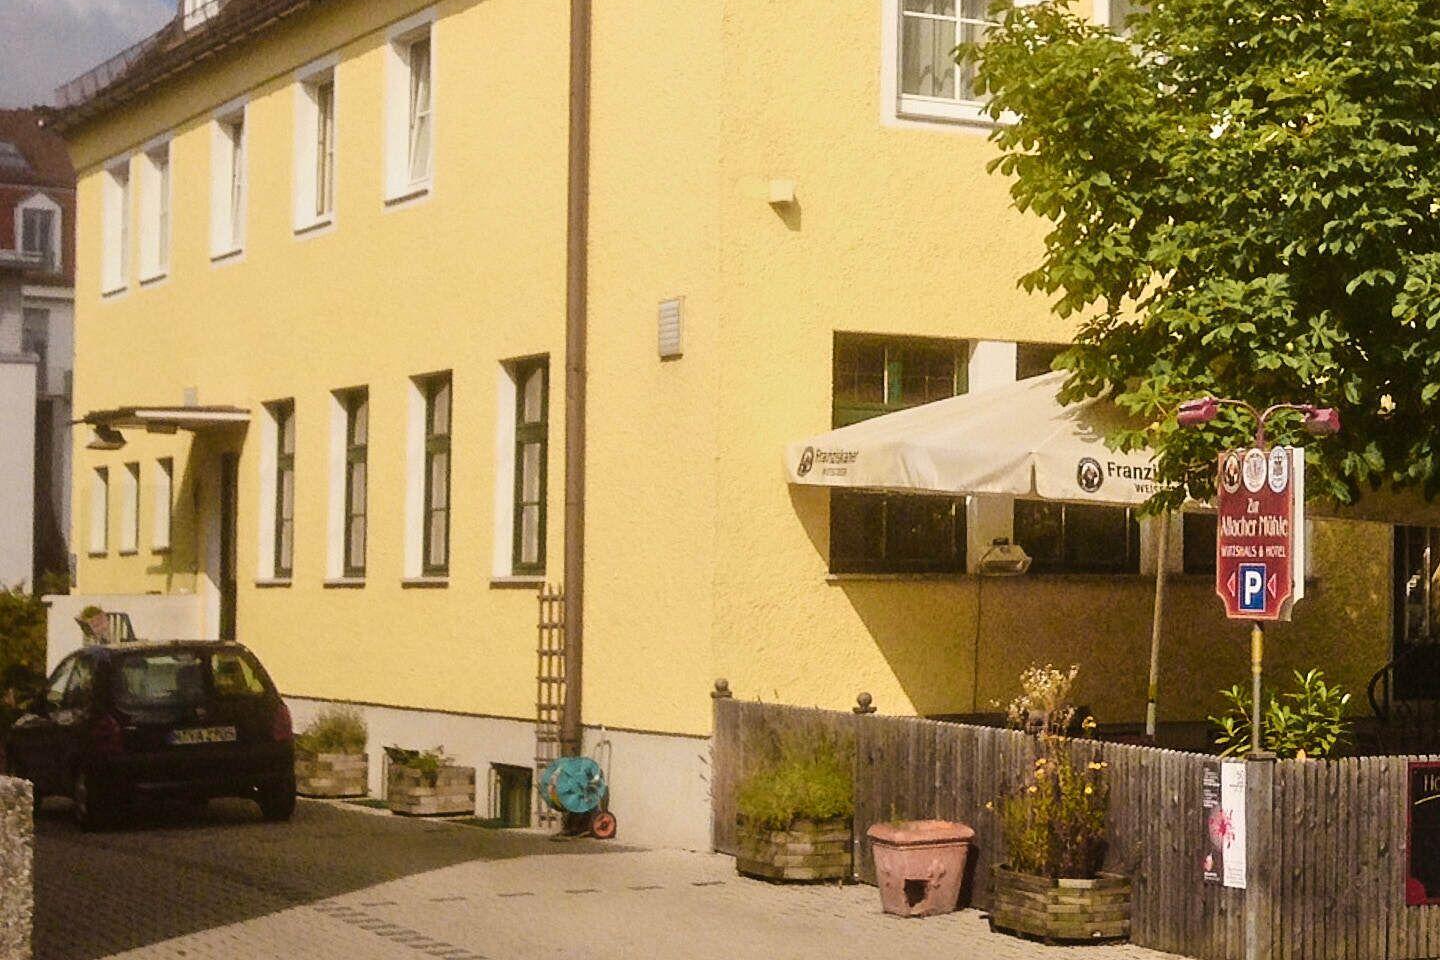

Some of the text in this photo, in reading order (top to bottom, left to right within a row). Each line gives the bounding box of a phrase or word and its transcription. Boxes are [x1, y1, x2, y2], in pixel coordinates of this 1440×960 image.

[1259, 515, 1288, 538] Mühle
[1266, 545, 1286, 558] HOTEL
[1245, 570, 1262, 606] P
